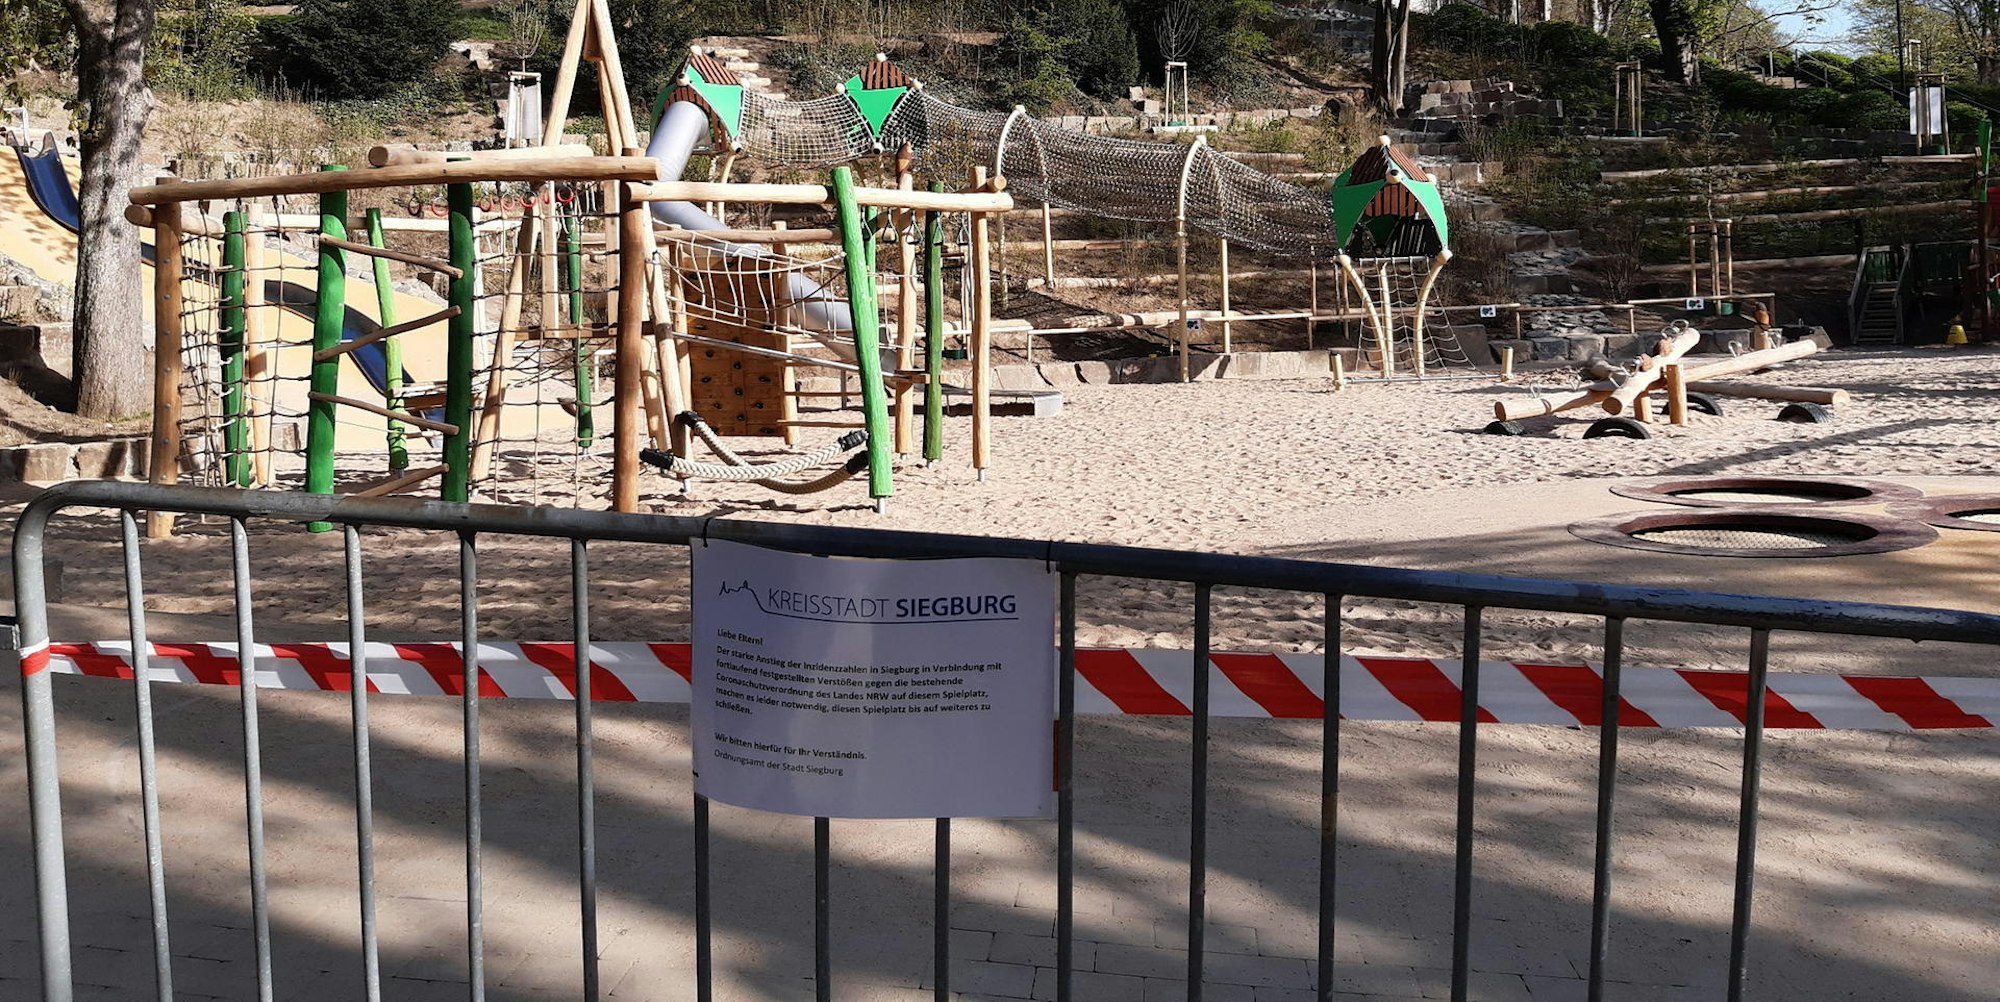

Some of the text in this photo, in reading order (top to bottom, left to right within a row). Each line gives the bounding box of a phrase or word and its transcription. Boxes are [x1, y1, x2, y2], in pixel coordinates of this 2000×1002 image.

[768, 587, 1017, 618] KREISSTADT SIEGBURG
[717, 629, 763, 646] Liebe Eltern!
[716, 645, 1002, 675] Der starke Anstieg der Inzidenzzahlen in Siegburg in Verbindung mit
[716, 659, 964, 688] fortlaufend festgestellten Verstößen gegen die bestehende
[716, 672, 989, 701] Coronaschutzverordnung des Landes NRW auf diesem Spielplatz,
[715, 687, 745, 700] machen
[746, 694, 755, 702] es
[756, 695, 779, 707] leider
[781, 700, 829, 714] notwendig,
[831, 703, 861, 713] diesen
[862, 705, 906, 715] Spielplatz
[908, 705, 921, 713] bis
[923, 704, 938, 713] auf
[940, 703, 979, 712] weiteres
[715, 700, 753, 715] schließen.
[714, 732, 867, 760] Wir bitten hierfür für Ihr Verständnis.
[714, 749, 844, 777] Ordnungsamt der Stadt Siegburg
